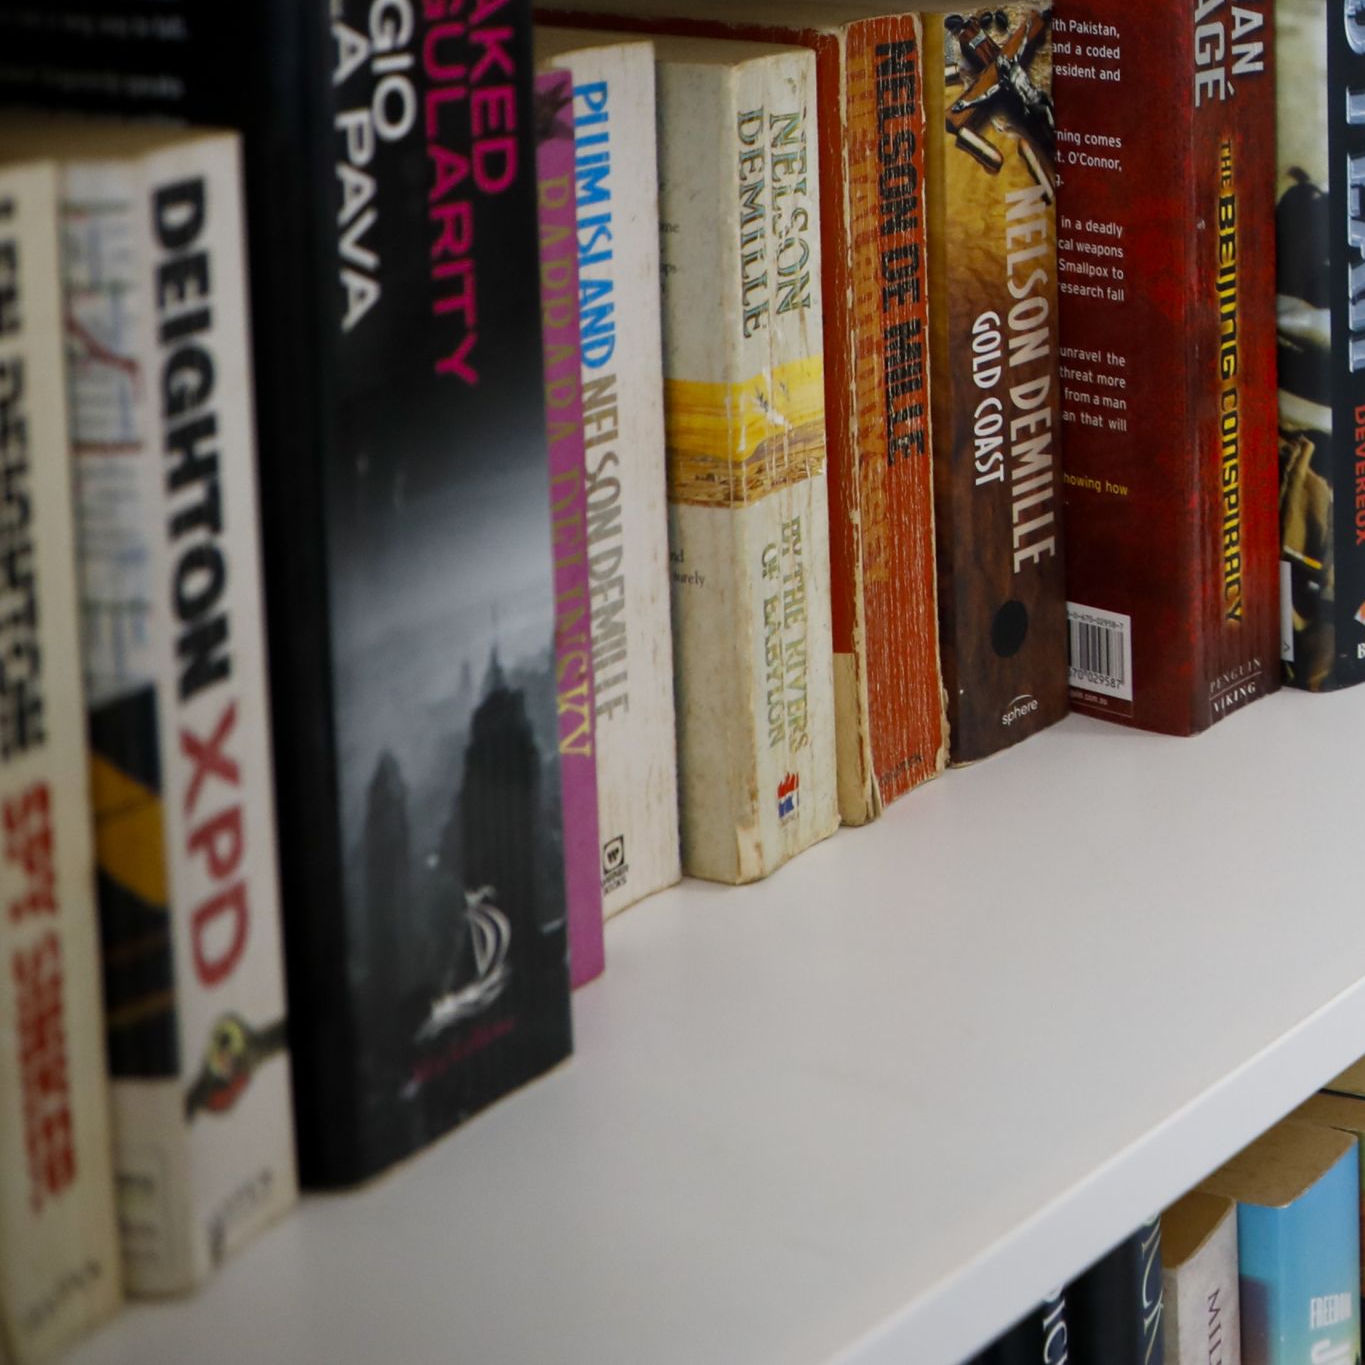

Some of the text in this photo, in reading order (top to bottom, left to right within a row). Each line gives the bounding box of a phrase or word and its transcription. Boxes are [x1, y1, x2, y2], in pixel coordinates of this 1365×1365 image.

[1068, 19, 1121, 39] Pakistan,
[1086, 45, 1121, 60] coded
[1099, 69, 1121, 82] and
[1084, 135, 1122, 149] comes
[1068, 151, 1123, 172] O'Connor,
[1220, 138, 1233, 189] THE
[334, 108, 381, 332] PAVA
[735, 107, 771, 341] DEMILLE
[768, 110, 812, 317] NELSON
[1061, 215, 1072, 229] in
[1085, 216, 1124, 240] deadly
[875, 37, 927, 467] NELSON DE MILLE
[1058, 258, 1125, 280] Smallpox to
[1076, 243, 1125, 259] weapons
[575, 214, 619, 370] ISLAND
[1107, 286, 1125, 303] fall
[1059, 346, 1126, 367] unravel the
[1004, 185, 1057, 576] NELSON DEMILLE
[1059, 366, 1127, 389] threat more
[970, 310, 1006, 489] GOLD COAST
[1064, 386, 1091, 404] from
[1102, 395, 1127, 410] man
[1080, 410, 1104, 428] that
[1108, 417, 1128, 433] will
[581, 374, 624, 548] NELSON
[853, 343, 892, 584] ODYSSEY
[1105, 479, 1129, 496] how
[1220, 394, 1243, 623] CONSPIRACY
[150, 176, 250, 993] DEIGHTON XPD
[782, 562, 809, 630] THE
[762, 593, 786, 749] BABYLON
[1209, 657, 1262, 694] PENGUIN
[784, 637, 810, 756] RIVERS
[1001, 697, 1039, 729] sphere
[1213, 681, 1257, 714] VIKING
[1309, 1291, 1353, 1330] FREEDOM
